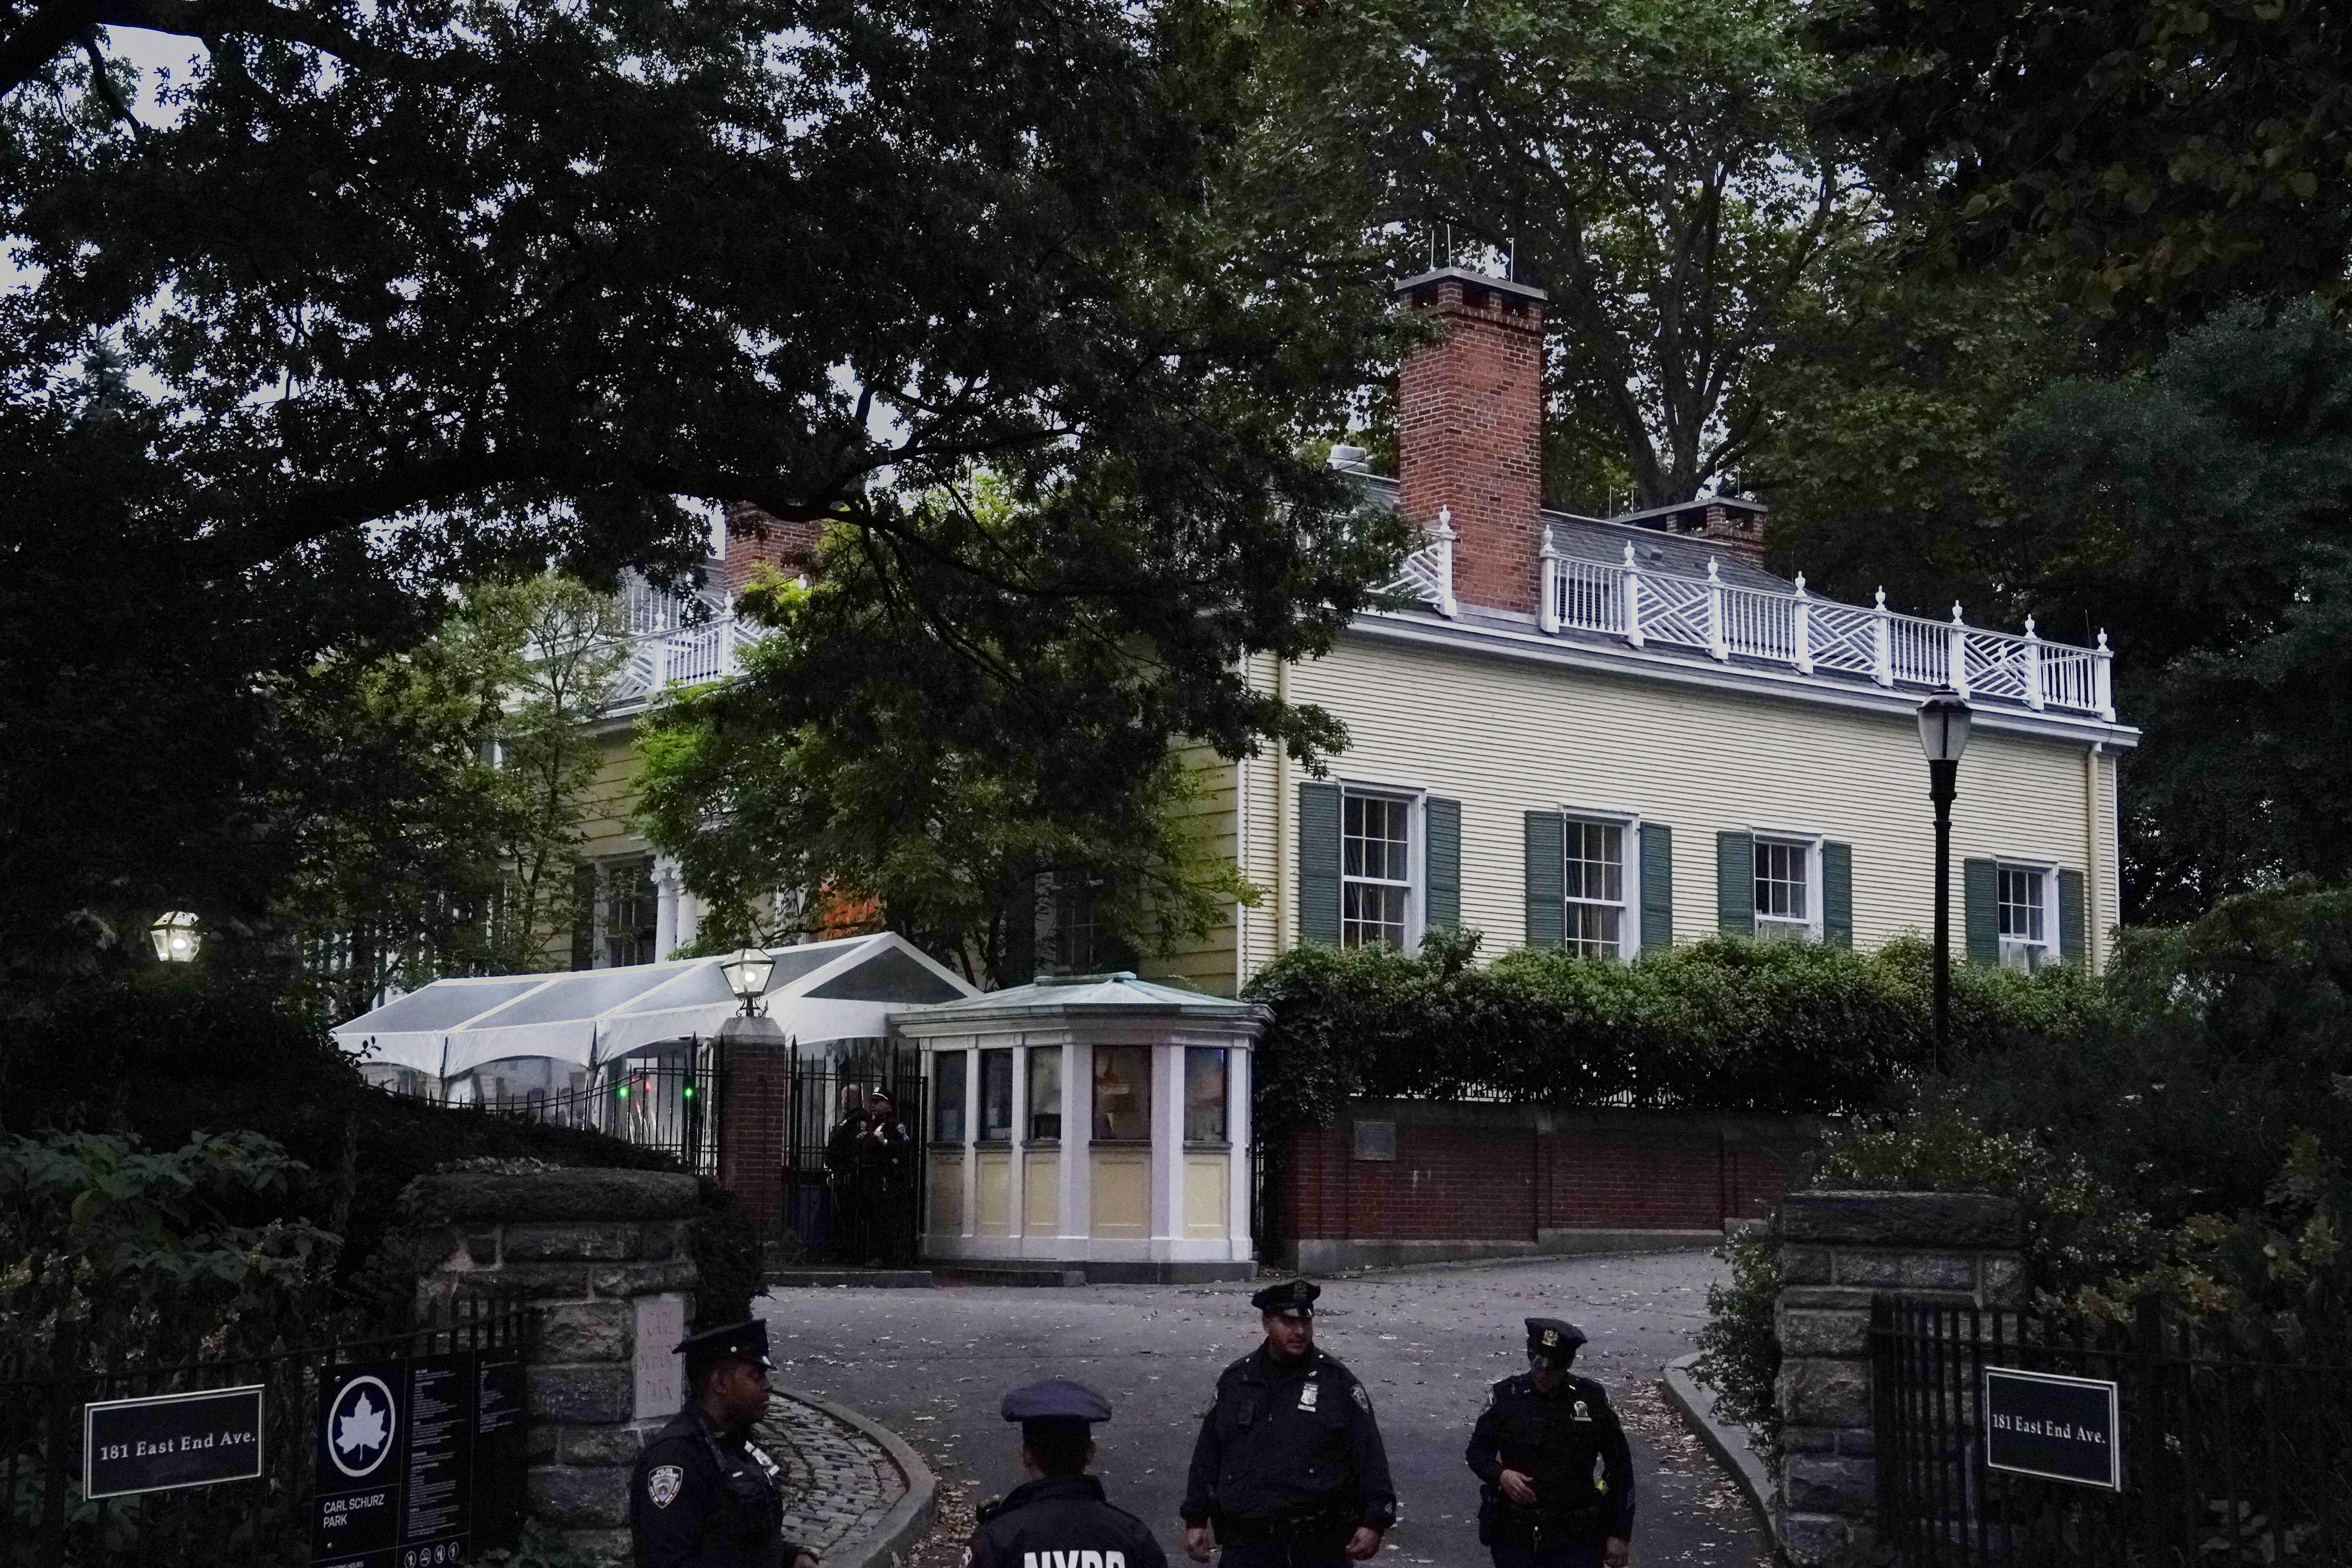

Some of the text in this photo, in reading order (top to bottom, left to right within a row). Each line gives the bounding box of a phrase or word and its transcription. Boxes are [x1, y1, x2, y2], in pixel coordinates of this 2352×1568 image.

[1993, 1414, 2106, 1444] 181 East End Ave.
[100, 1431, 256, 1460] 181 East End Ave.
[324, 1494, 385, 1514] CARL SCHURZ
[323, 1514, 348, 1529] PARK
